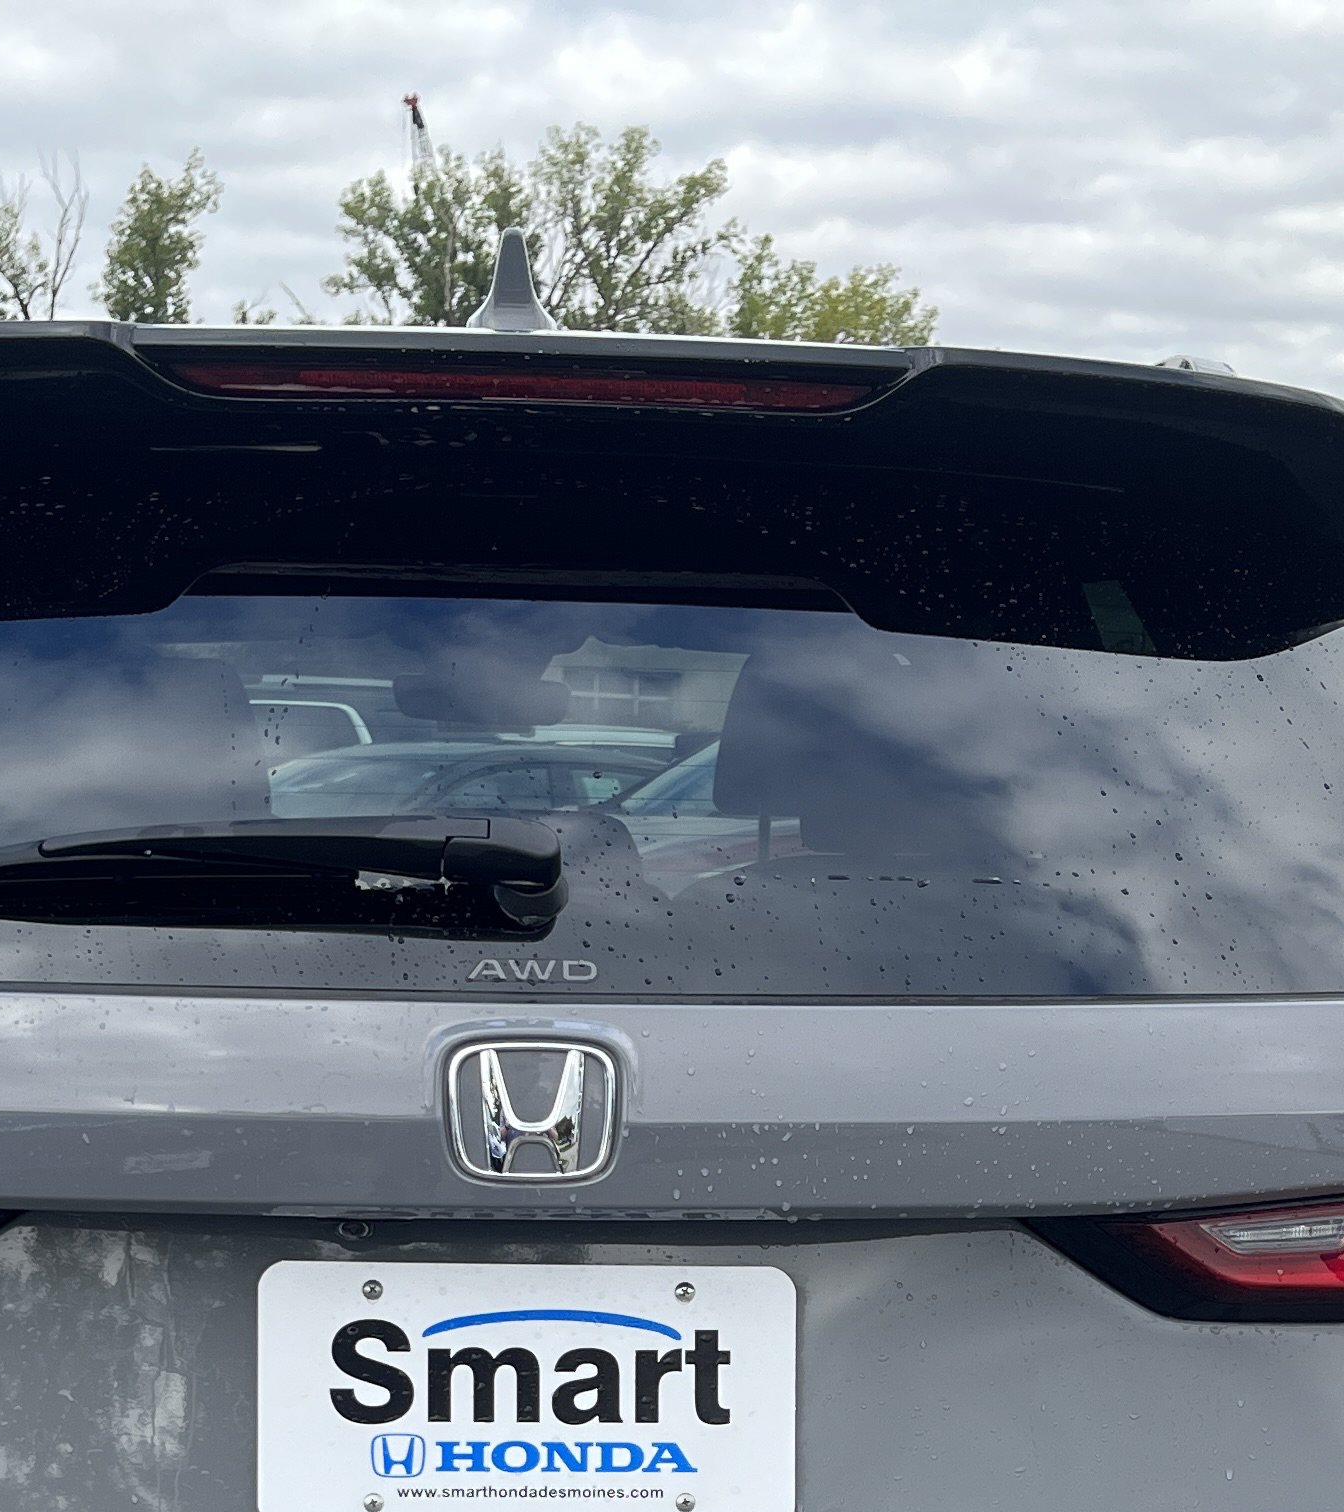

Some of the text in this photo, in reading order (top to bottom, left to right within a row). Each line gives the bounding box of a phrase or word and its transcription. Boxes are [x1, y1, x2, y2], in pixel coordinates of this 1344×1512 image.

[467, 958, 598, 981] AWD
[329, 1319, 731, 1425] Smart
[436, 1441, 698, 1473] HONDA
[397, 1485, 665, 1500] www.smarthondadesmoines.com
